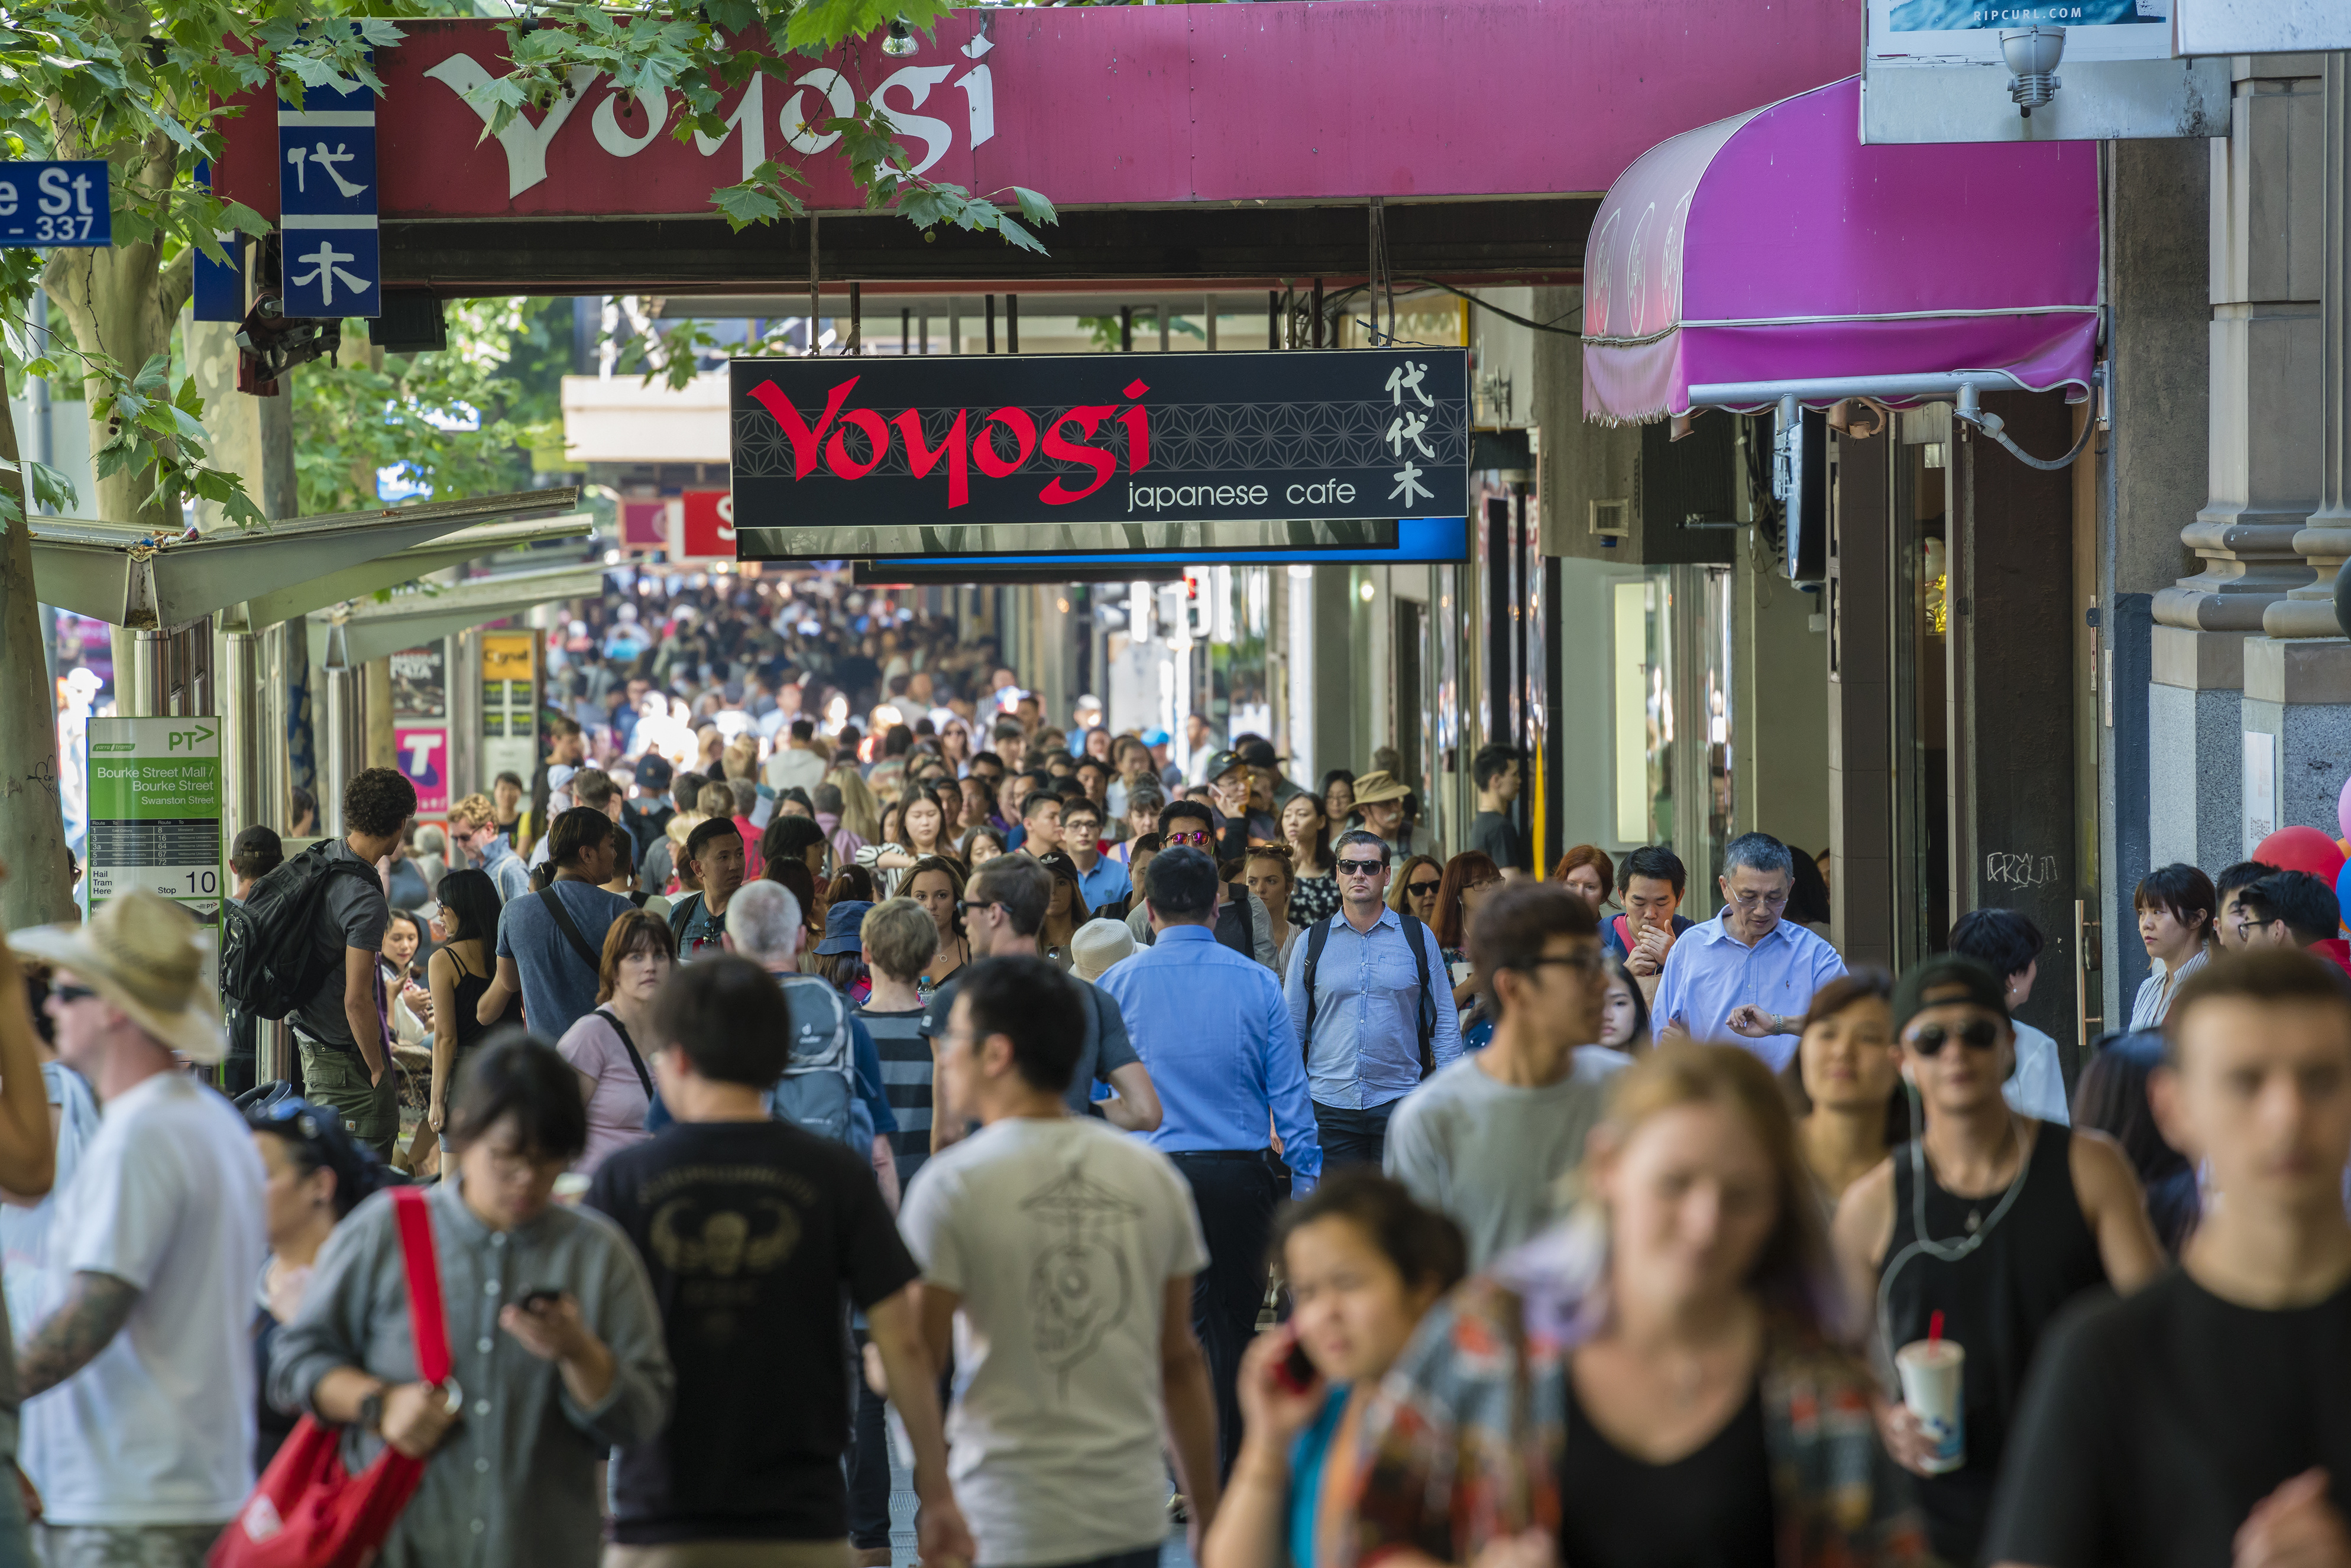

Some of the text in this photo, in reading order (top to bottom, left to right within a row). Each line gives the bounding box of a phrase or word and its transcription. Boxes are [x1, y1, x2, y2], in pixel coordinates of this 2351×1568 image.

[1974, 7, 2082, 21] RIPCURL.COM
[38, 167, 93, 215] St
[35, 215, 93, 241] 337
[746, 375, 1150, 509] Yoyogi
[1385, 361, 1434, 508] 代代木
[1128, 478, 1356, 512] japanese cafe
[98, 767, 140, 778] Bourke
[143, 766, 179, 778] Street
[182, 766, 206, 777] Mall
[132, 780, 213, 792] Bourke Street
[141, 796, 214, 805] Swanston Street
[186, 871, 216, 893] 10
